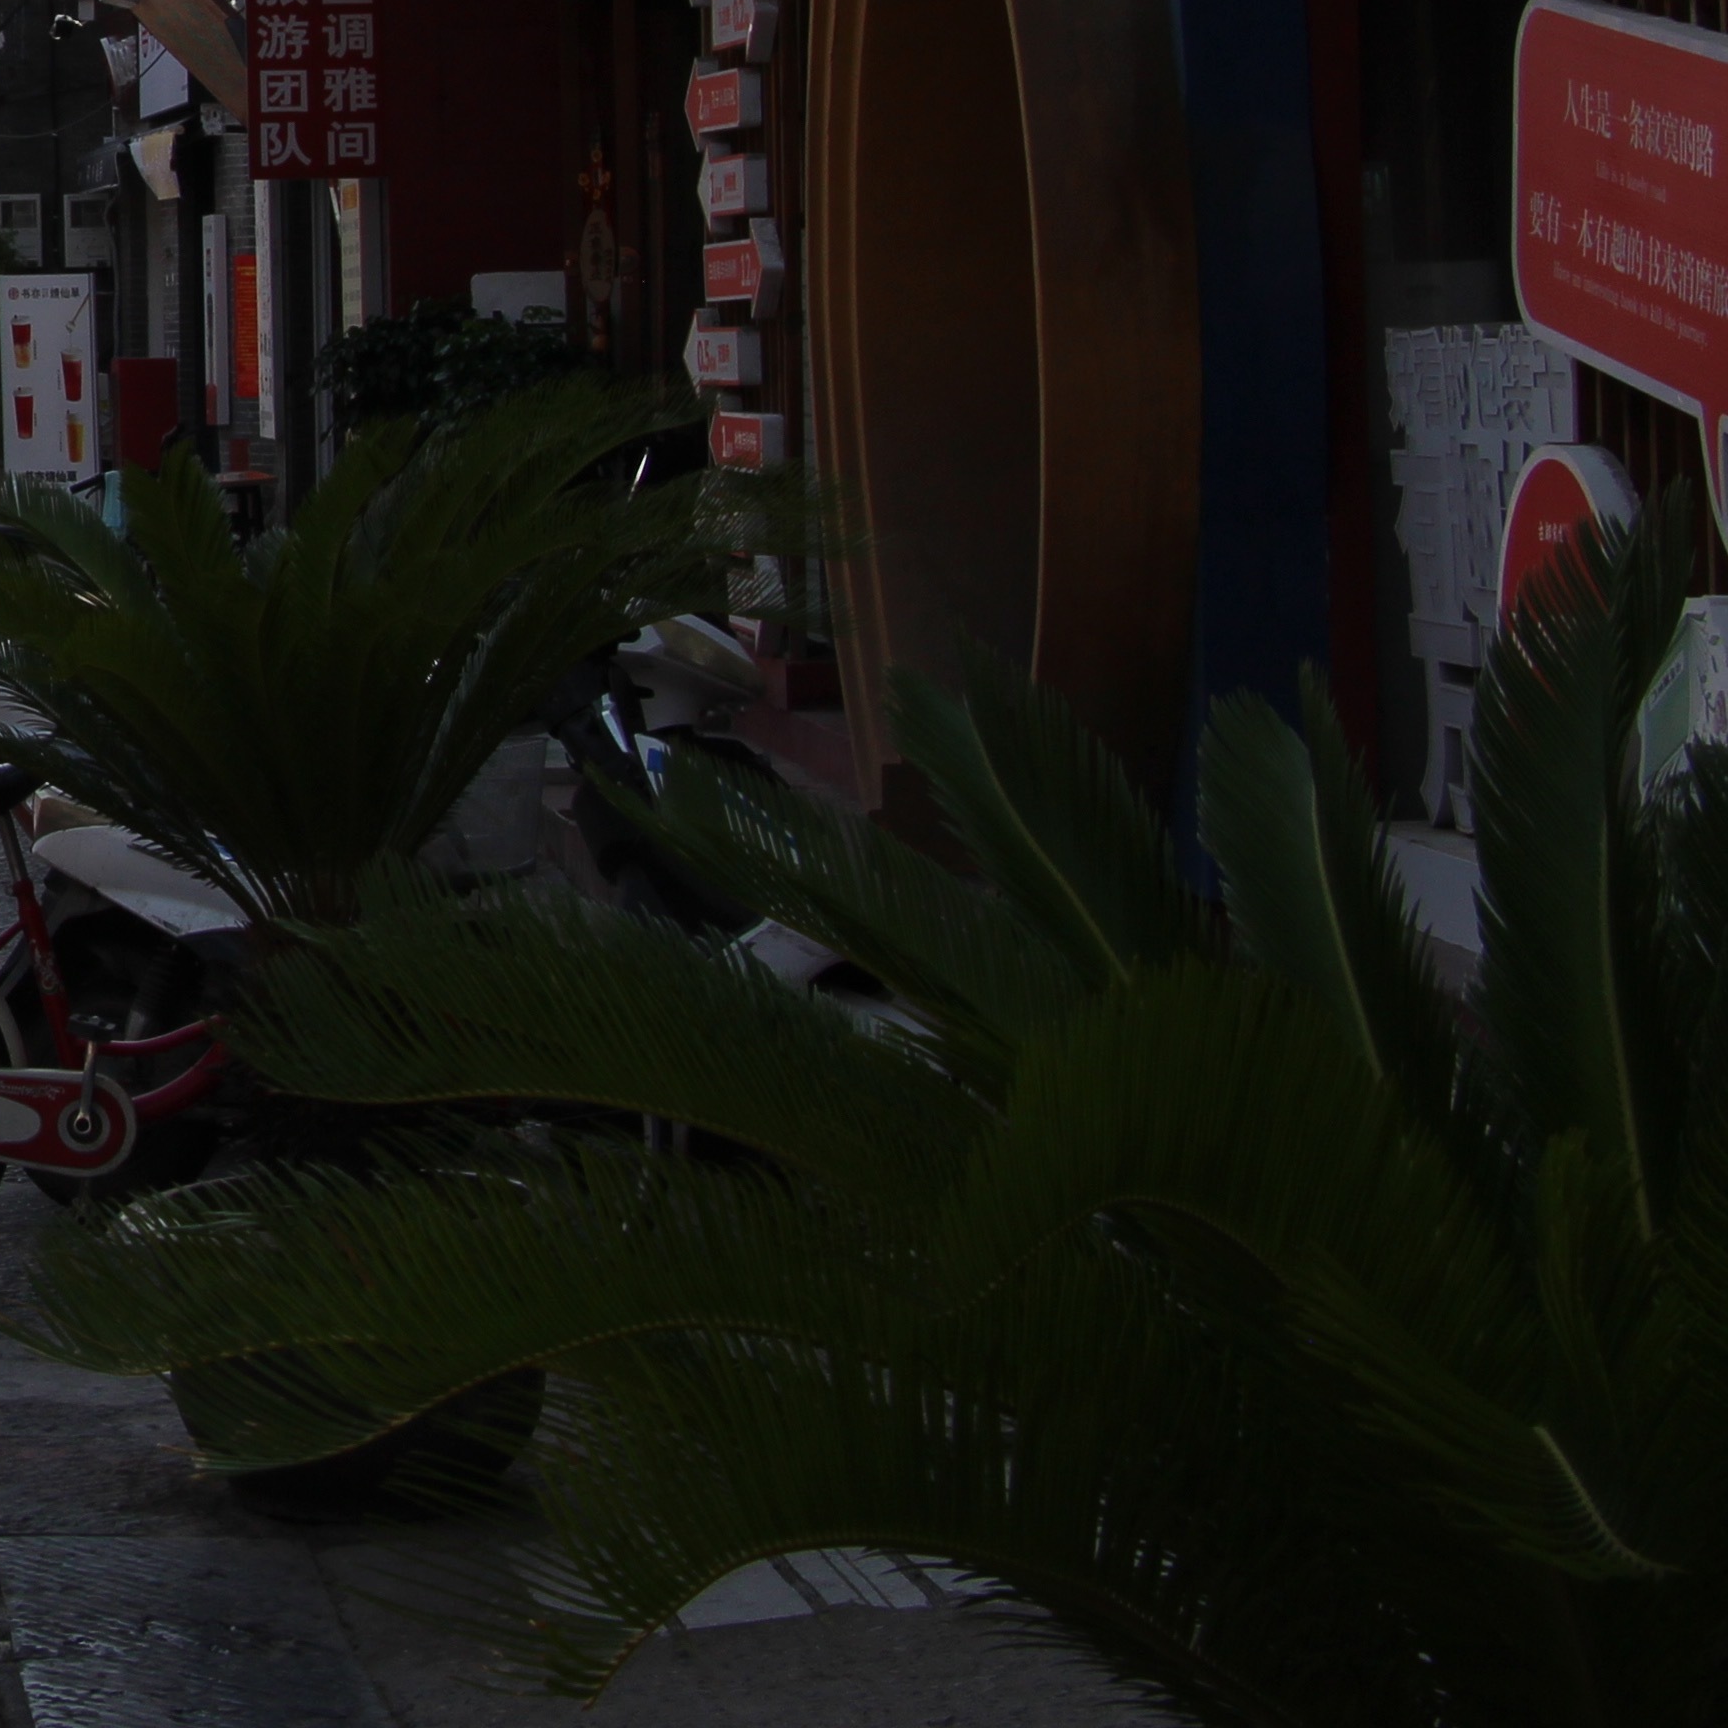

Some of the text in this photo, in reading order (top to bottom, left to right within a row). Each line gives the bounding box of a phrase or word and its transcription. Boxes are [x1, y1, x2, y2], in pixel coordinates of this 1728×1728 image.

[1563, 79, 1713, 178] 人生是一条寂寞的路
